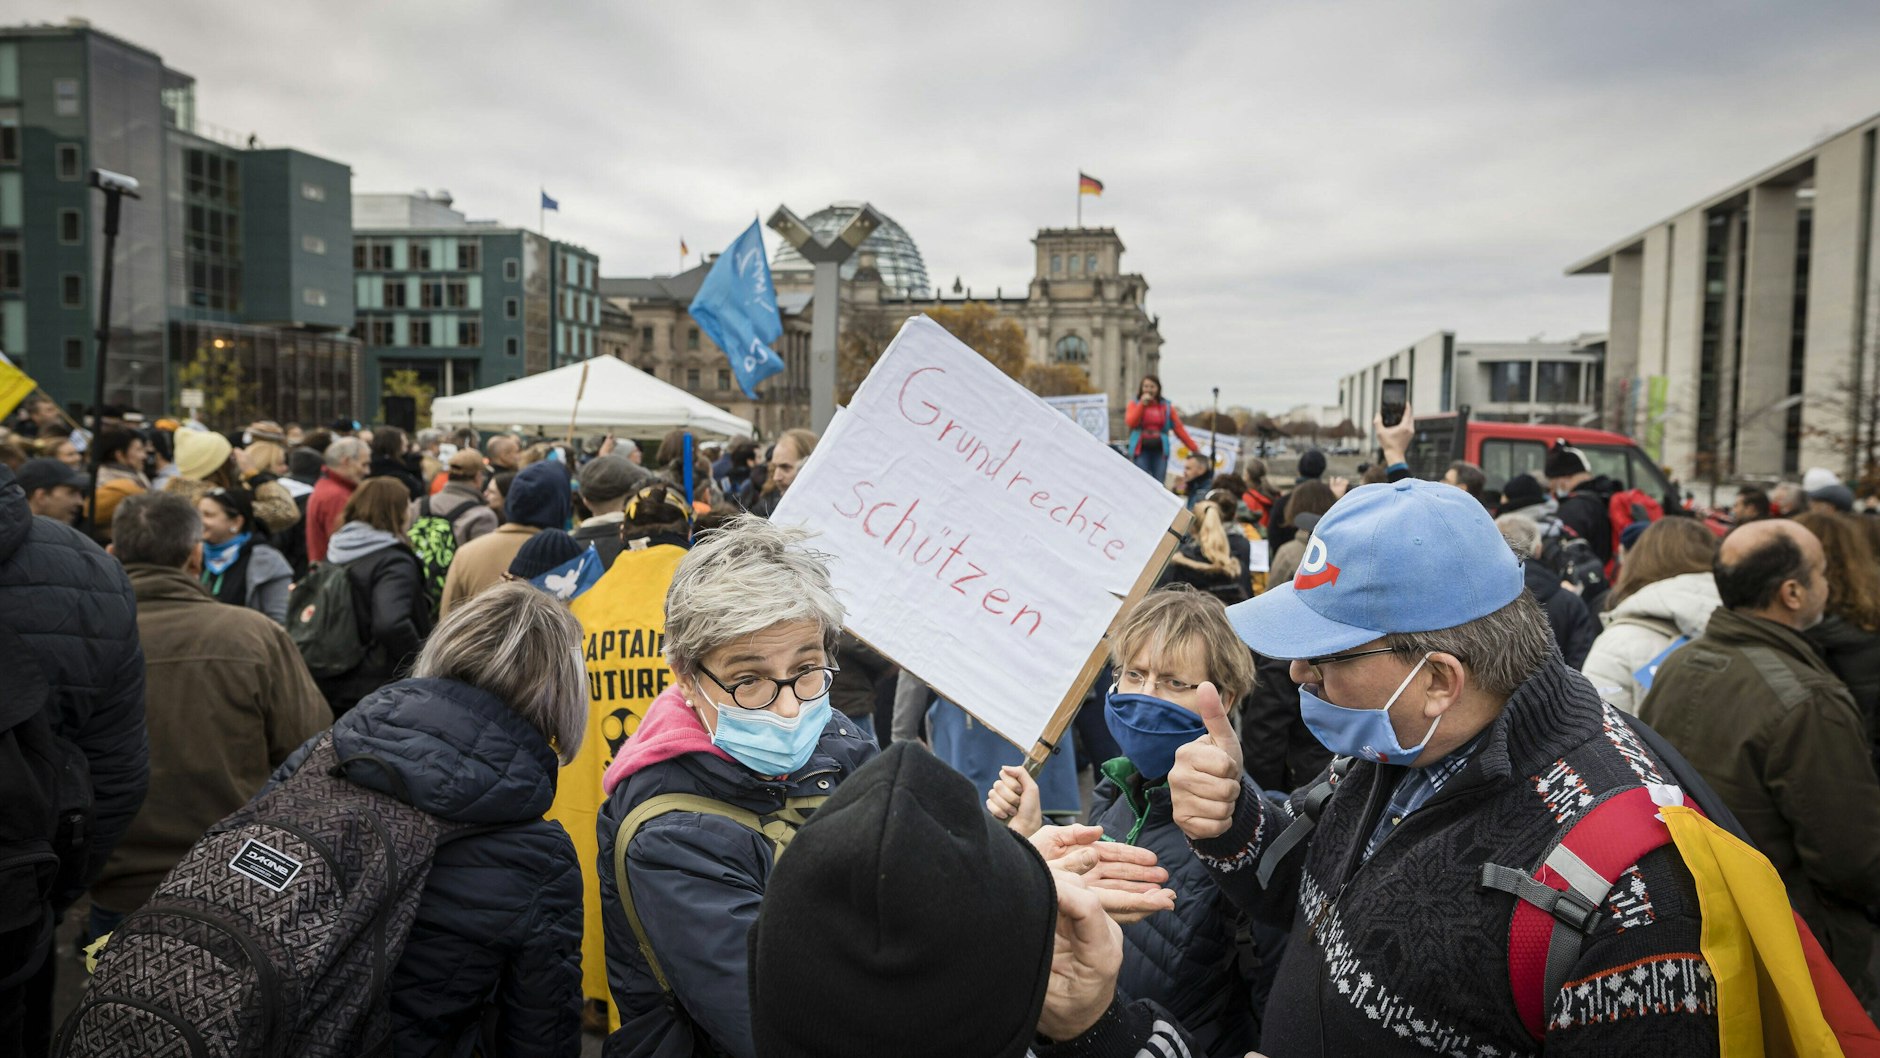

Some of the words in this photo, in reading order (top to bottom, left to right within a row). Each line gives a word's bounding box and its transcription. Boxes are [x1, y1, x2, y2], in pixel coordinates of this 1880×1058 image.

[898, 366, 1125, 562] Grundrechte
[583, 629, 665, 662] APTAI
[588, 668, 670, 701] UTURE
[245, 850, 289, 877] DAKINE
